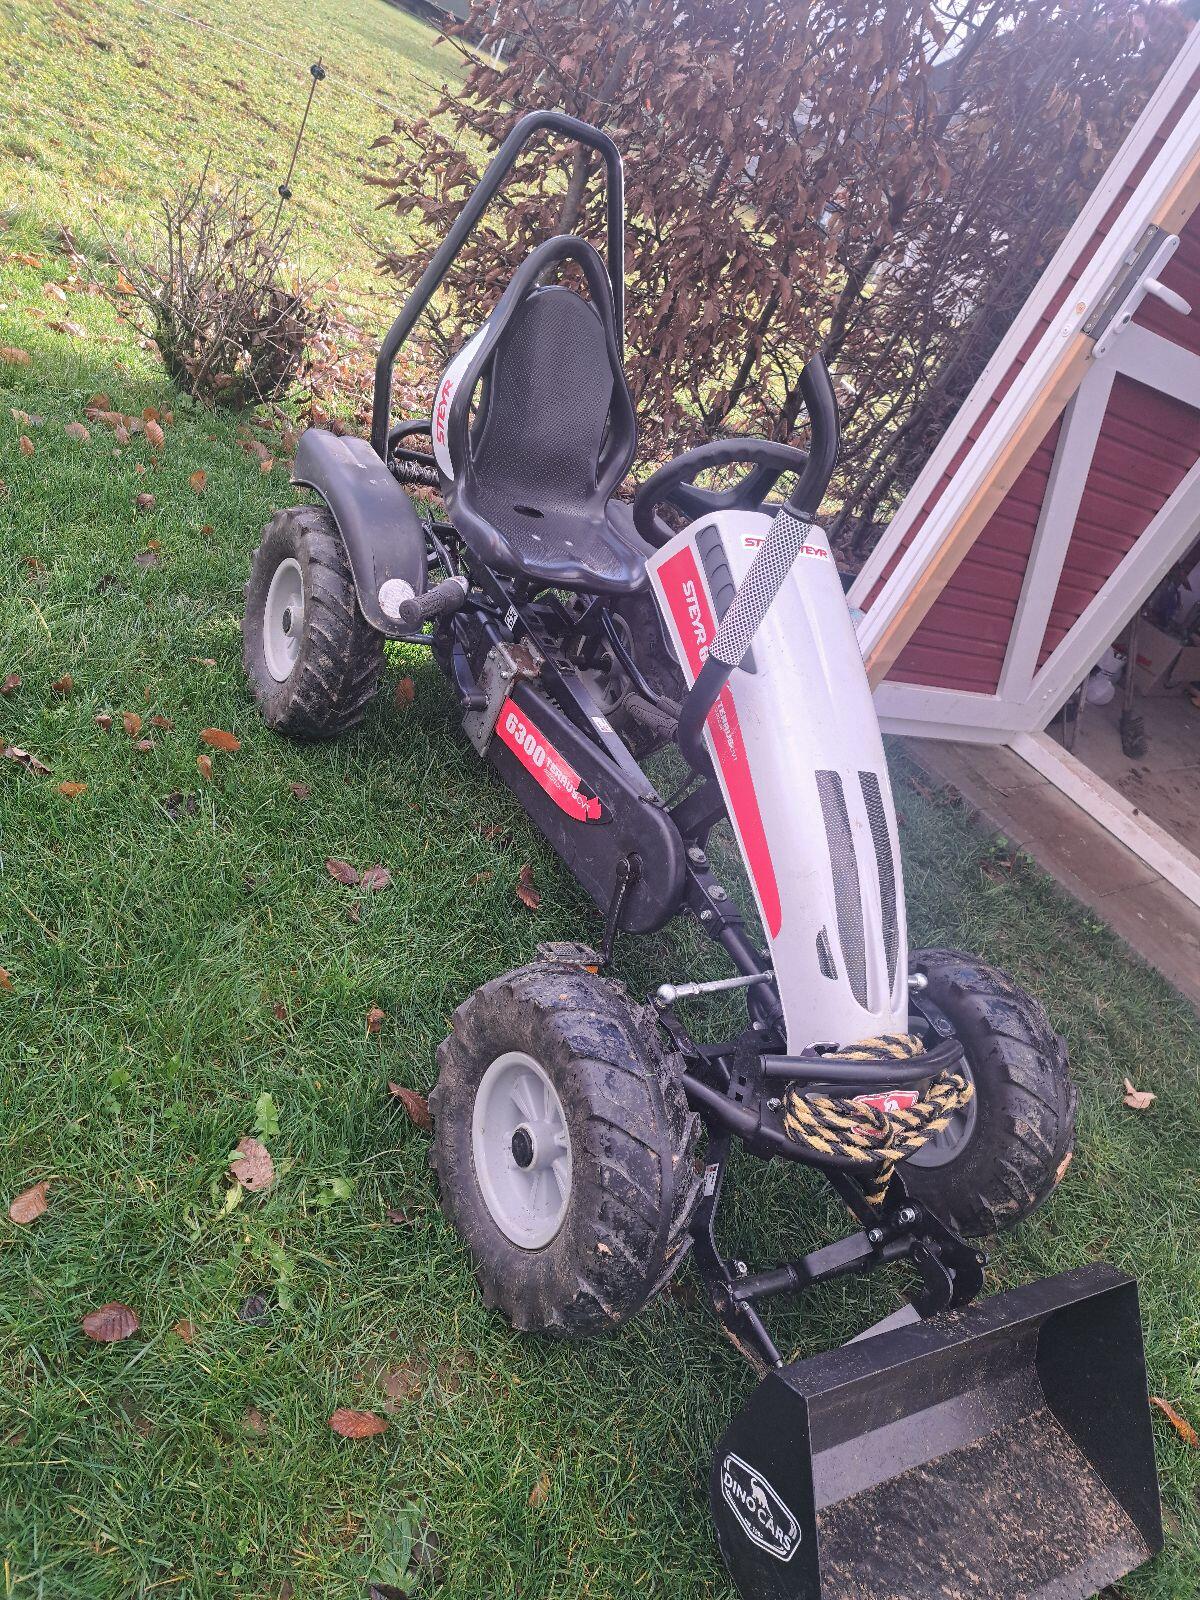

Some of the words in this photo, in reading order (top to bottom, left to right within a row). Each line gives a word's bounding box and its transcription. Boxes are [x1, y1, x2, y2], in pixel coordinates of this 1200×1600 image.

[436, 379, 453, 447] STEYR
[799, 545, 828, 559] TEYR
[682, 580, 707, 645] STEYR
[505, 712, 546, 768] 6300
[723, 1471, 756, 1512] DINO
[757, 1508, 792, 1551] CARS
